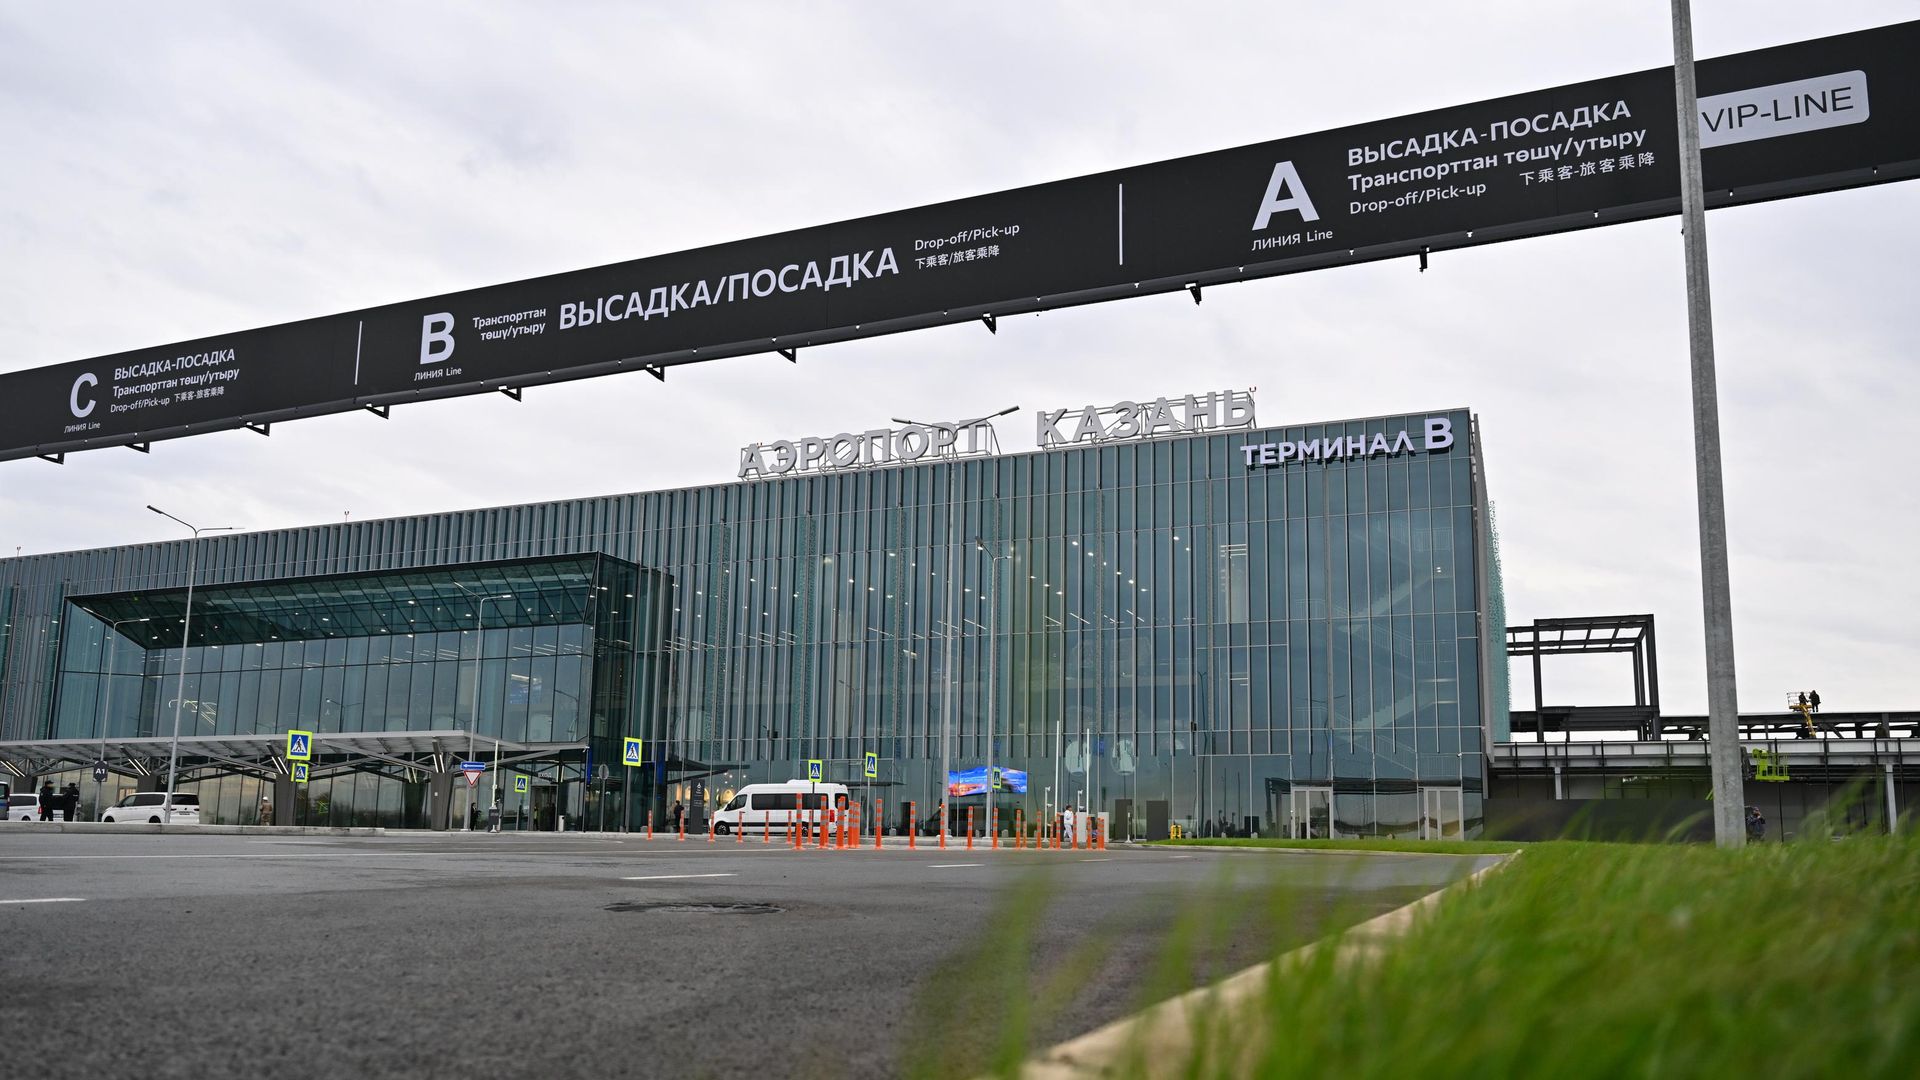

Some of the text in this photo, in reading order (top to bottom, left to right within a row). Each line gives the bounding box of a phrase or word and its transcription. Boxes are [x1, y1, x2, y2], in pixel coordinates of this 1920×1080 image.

[1701, 86, 1854, 133] VIP-LINE
[1348, 100, 1632, 167] ВЫСАДКА-ПОСАДКА
[1347, 129, 1647, 193] Транспорттан төшү/утыру
[1251, 160, 1320, 231] A
[1349, 151, 1656, 215] Drop-off/Pick-up 下乘客-旅客乘降
[914, 223, 1020, 251] Drop-off/Pick-up
[1251, 230, 1334, 252] ЛИНИЯ Line
[914, 244, 1000, 270] 下乘客/旅客乘降
[558, 247, 900, 330] ВЫСАДКА/ПОСАДКА
[472, 308, 547, 330] Транспорттан
[480, 322, 546, 341] төшү/утыру
[419, 311, 456, 365] B
[113, 348, 236, 381] ВЫСАДКА-ПОСАДКА
[414, 366, 462, 381] ЛИНИЯ Line
[69, 372, 98, 418] C
[112, 368, 240, 399] Транспорттан төшү/утыру
[110, 396, 170, 413] Drop-off/Pick-up
[64, 421, 101, 433] ЛИНИЯ Line
[737, 389, 1255, 477] АЭРОПОРТ КАЗАНЬ
[1240, 430, 1415, 466] ТЕРМИНАЛ
